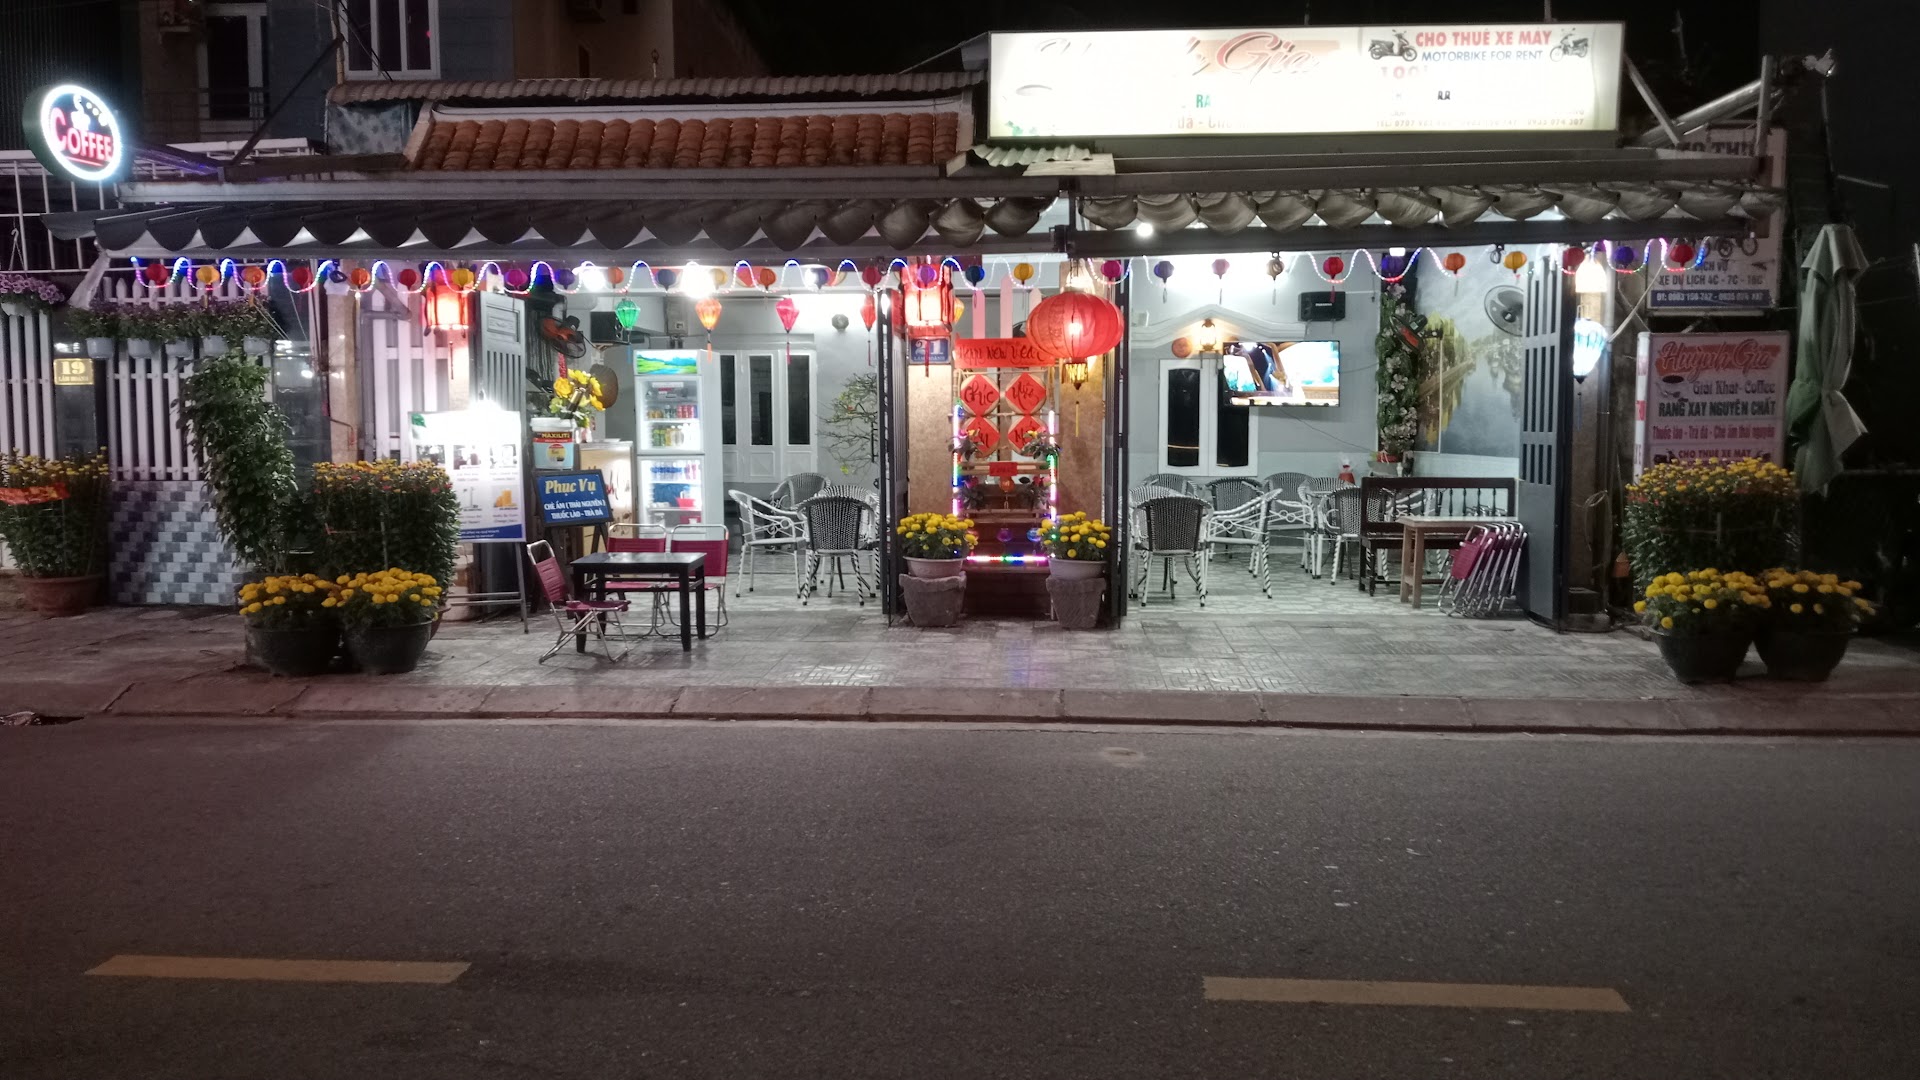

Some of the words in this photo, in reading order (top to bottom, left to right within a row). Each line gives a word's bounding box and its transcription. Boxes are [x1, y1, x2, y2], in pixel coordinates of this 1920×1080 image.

[1415, 31, 1447, 47] CHO
[1496, 31, 1513, 46] XE
[1421, 51, 1487, 62] MOTORBIKE
[1490, 51, 1512, 61] FOR
[1516, 50, 1543, 61] RENT
[50, 107, 113, 163] COFFEE
[1658, 275, 1670, 286] XE
[915, 339, 945, 356] 21
[60, 361, 86, 375] 19
[1745, 379, 1776, 395] Coffee
[1658, 401, 1686, 417] RANG
[1688, 401, 1706, 417] XAY
[1678, 450, 1695, 459] CHO
[1721, 450, 1731, 458] XE
[545, 479, 577, 497] Phục
[578, 478, 596, 495] Vụ
